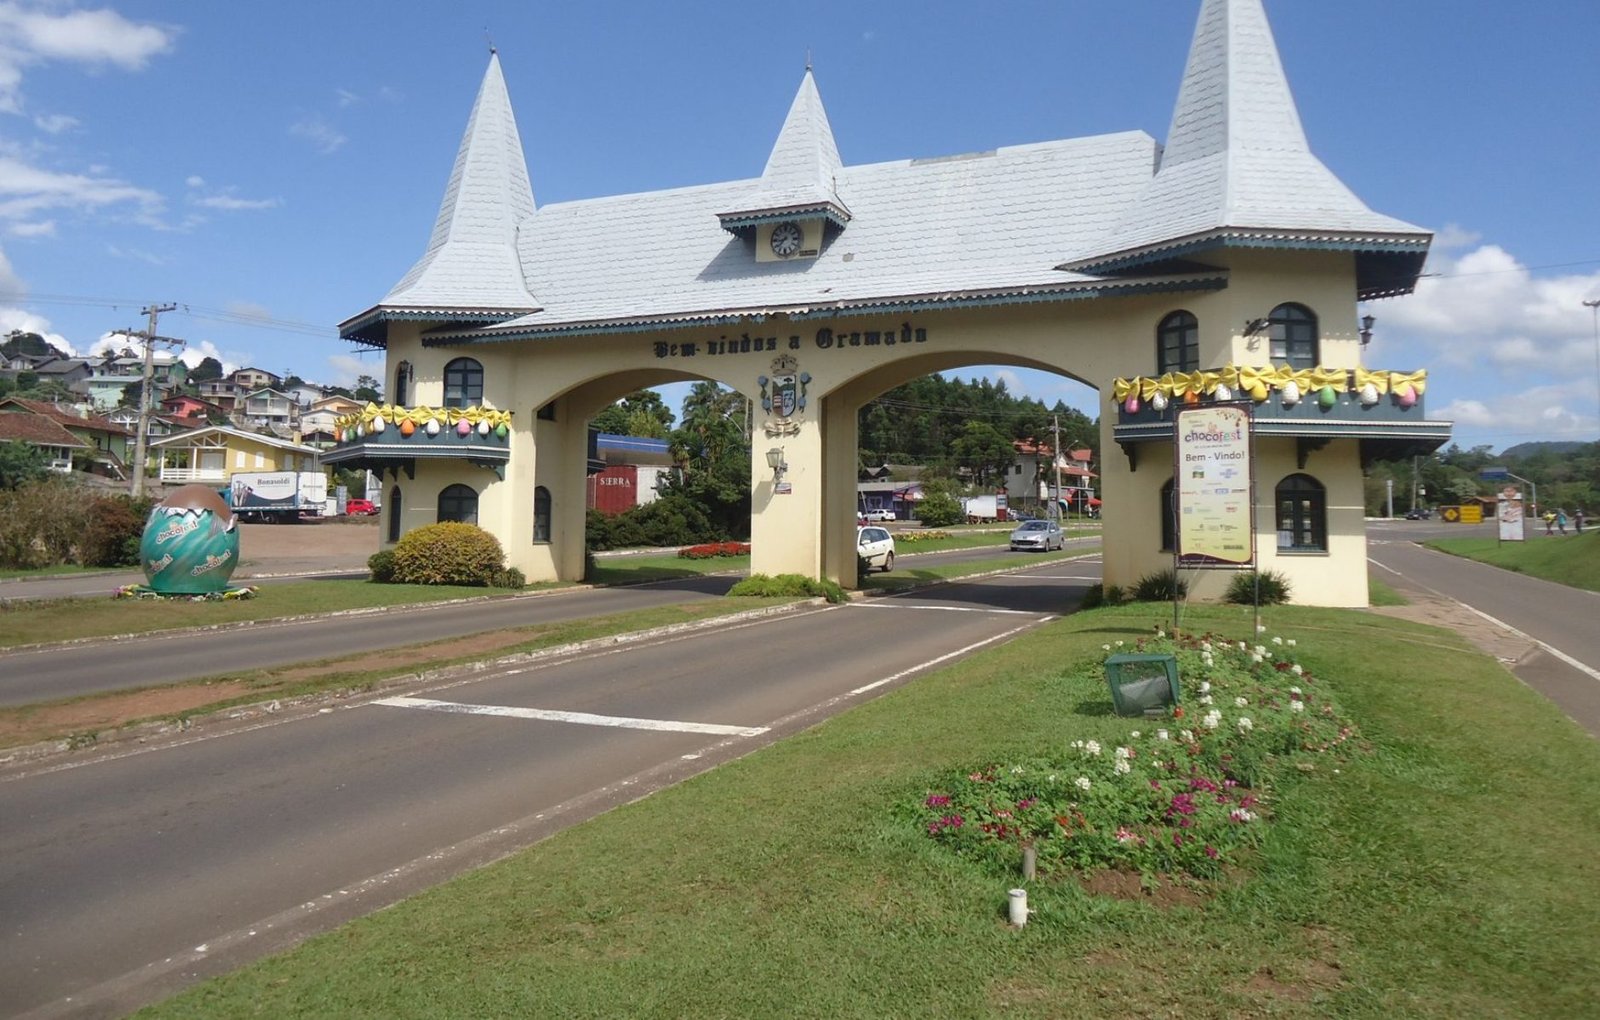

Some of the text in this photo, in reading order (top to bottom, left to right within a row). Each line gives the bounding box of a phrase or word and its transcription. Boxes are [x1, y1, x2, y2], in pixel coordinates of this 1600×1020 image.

[788, 335, 800, 350] a
[815, 321, 927, 349] Gramado
[1184, 429, 1242, 443] chocofest
[1185, 453, 1206, 462] Bem
[1214, 450, 1245, 460] Vindo!
